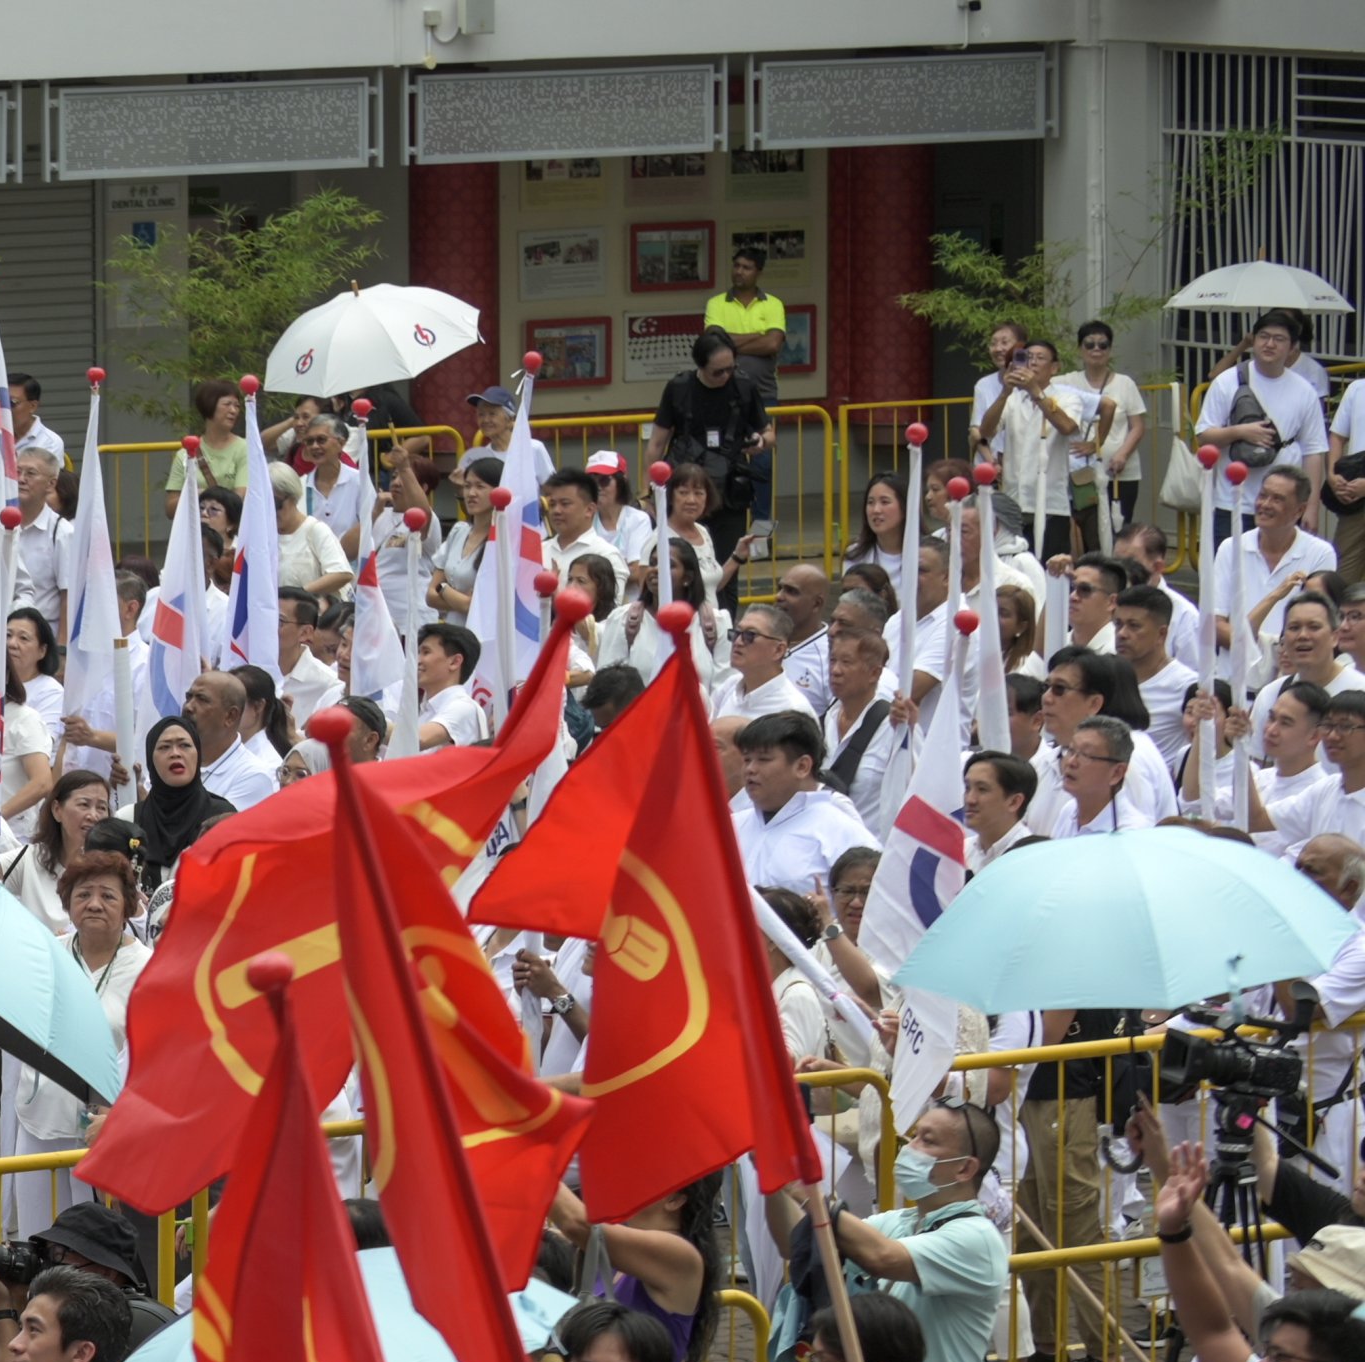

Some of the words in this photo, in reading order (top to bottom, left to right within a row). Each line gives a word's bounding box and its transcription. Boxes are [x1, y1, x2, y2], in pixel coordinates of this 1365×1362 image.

[111, 199, 144, 209] DENTAL
[147, 197, 175, 208] CLINIC
[901, 1008, 924, 1055] GRC
